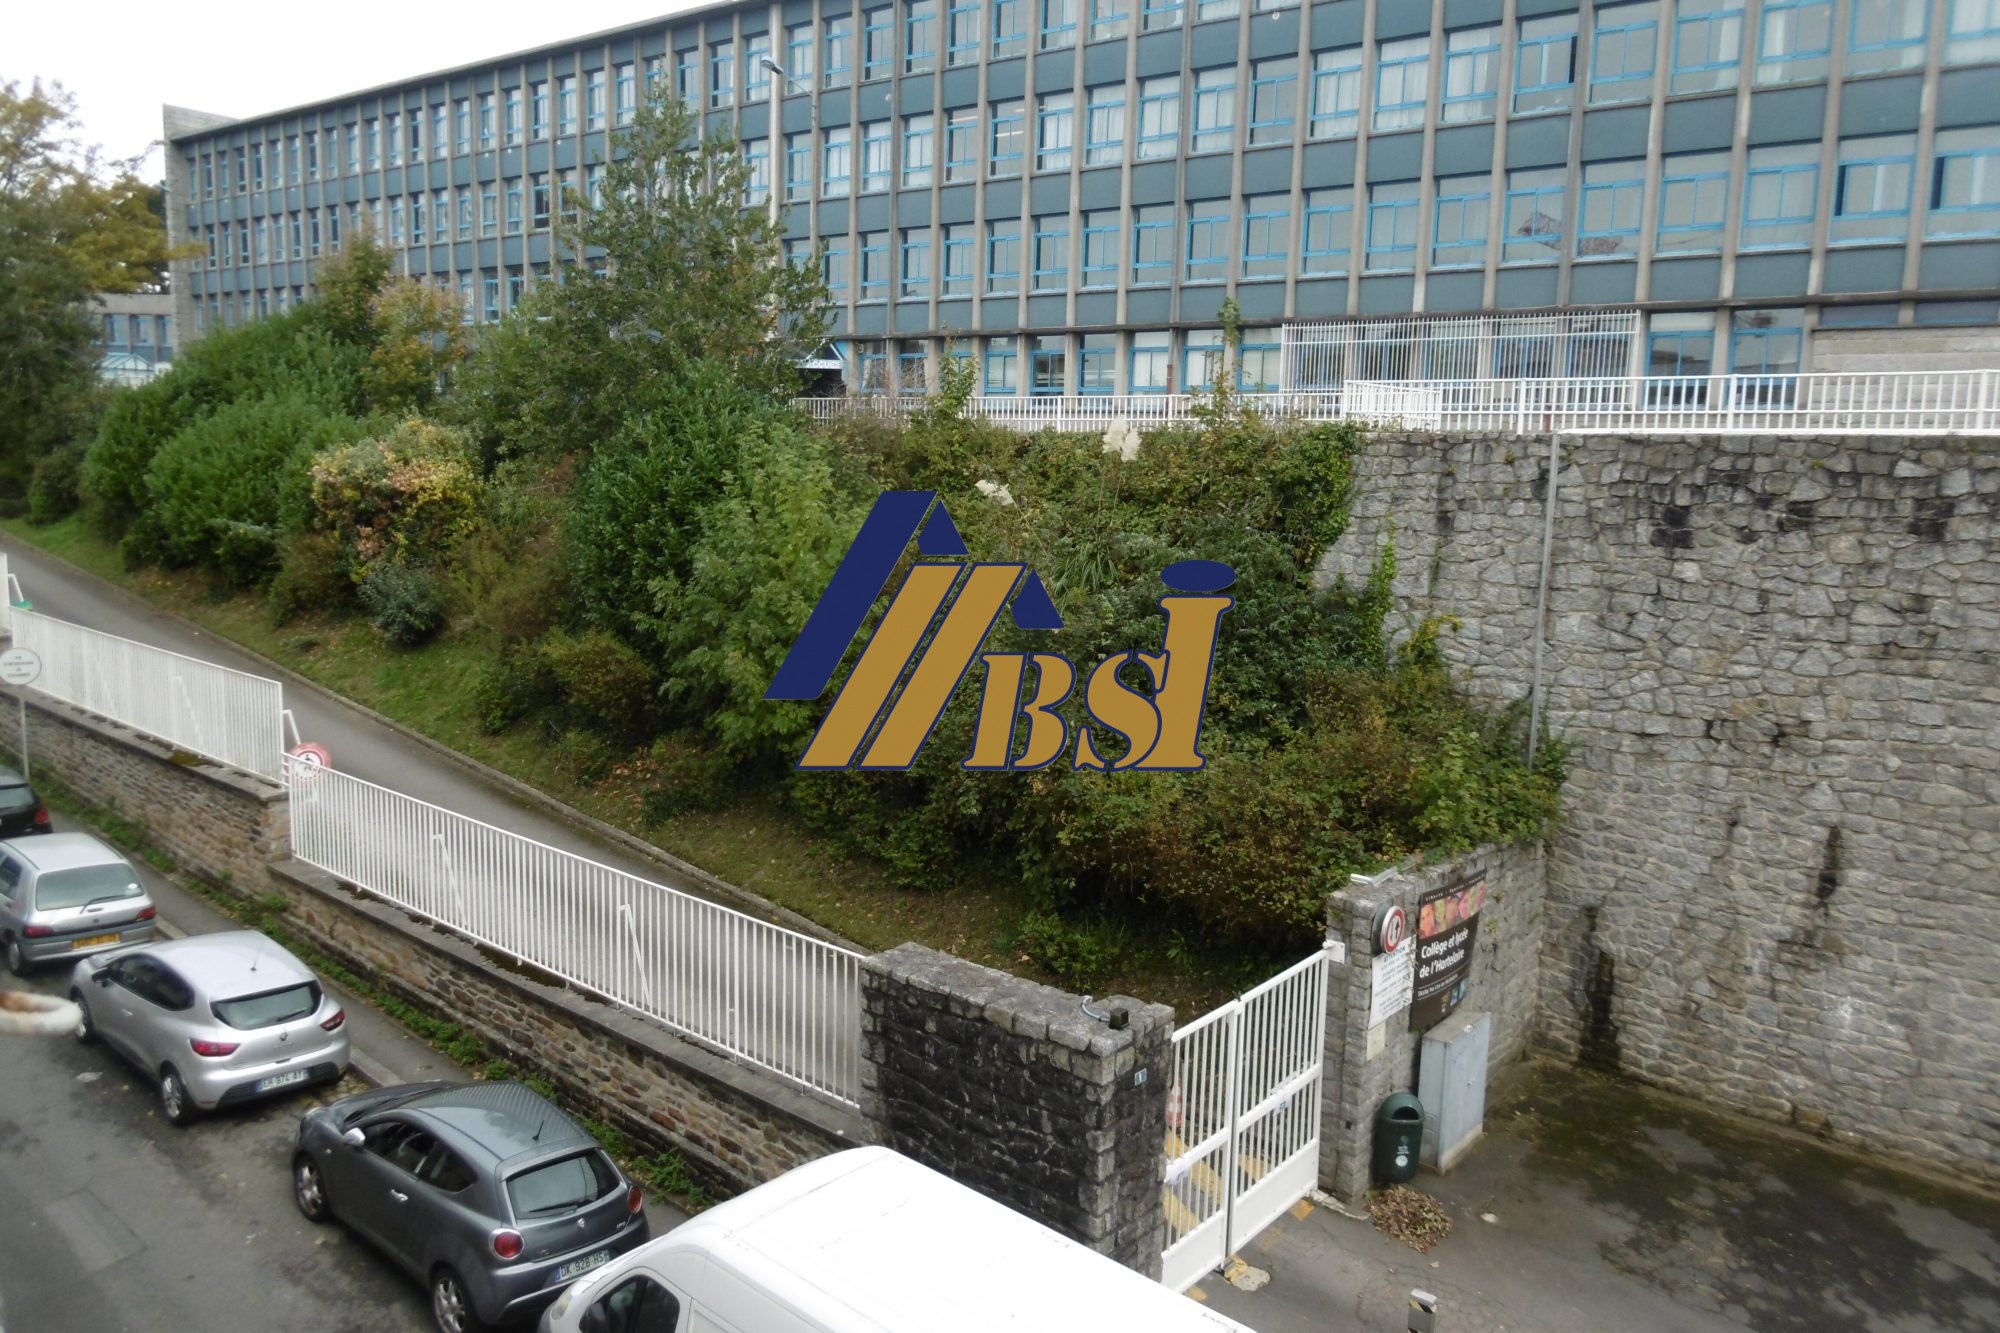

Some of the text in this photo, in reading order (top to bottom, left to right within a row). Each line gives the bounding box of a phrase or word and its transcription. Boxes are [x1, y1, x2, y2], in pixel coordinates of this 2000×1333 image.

[1421, 940, 1448, 959] Collège
[1448, 934, 1455, 948] et
[1419, 965, 1430, 979] de
